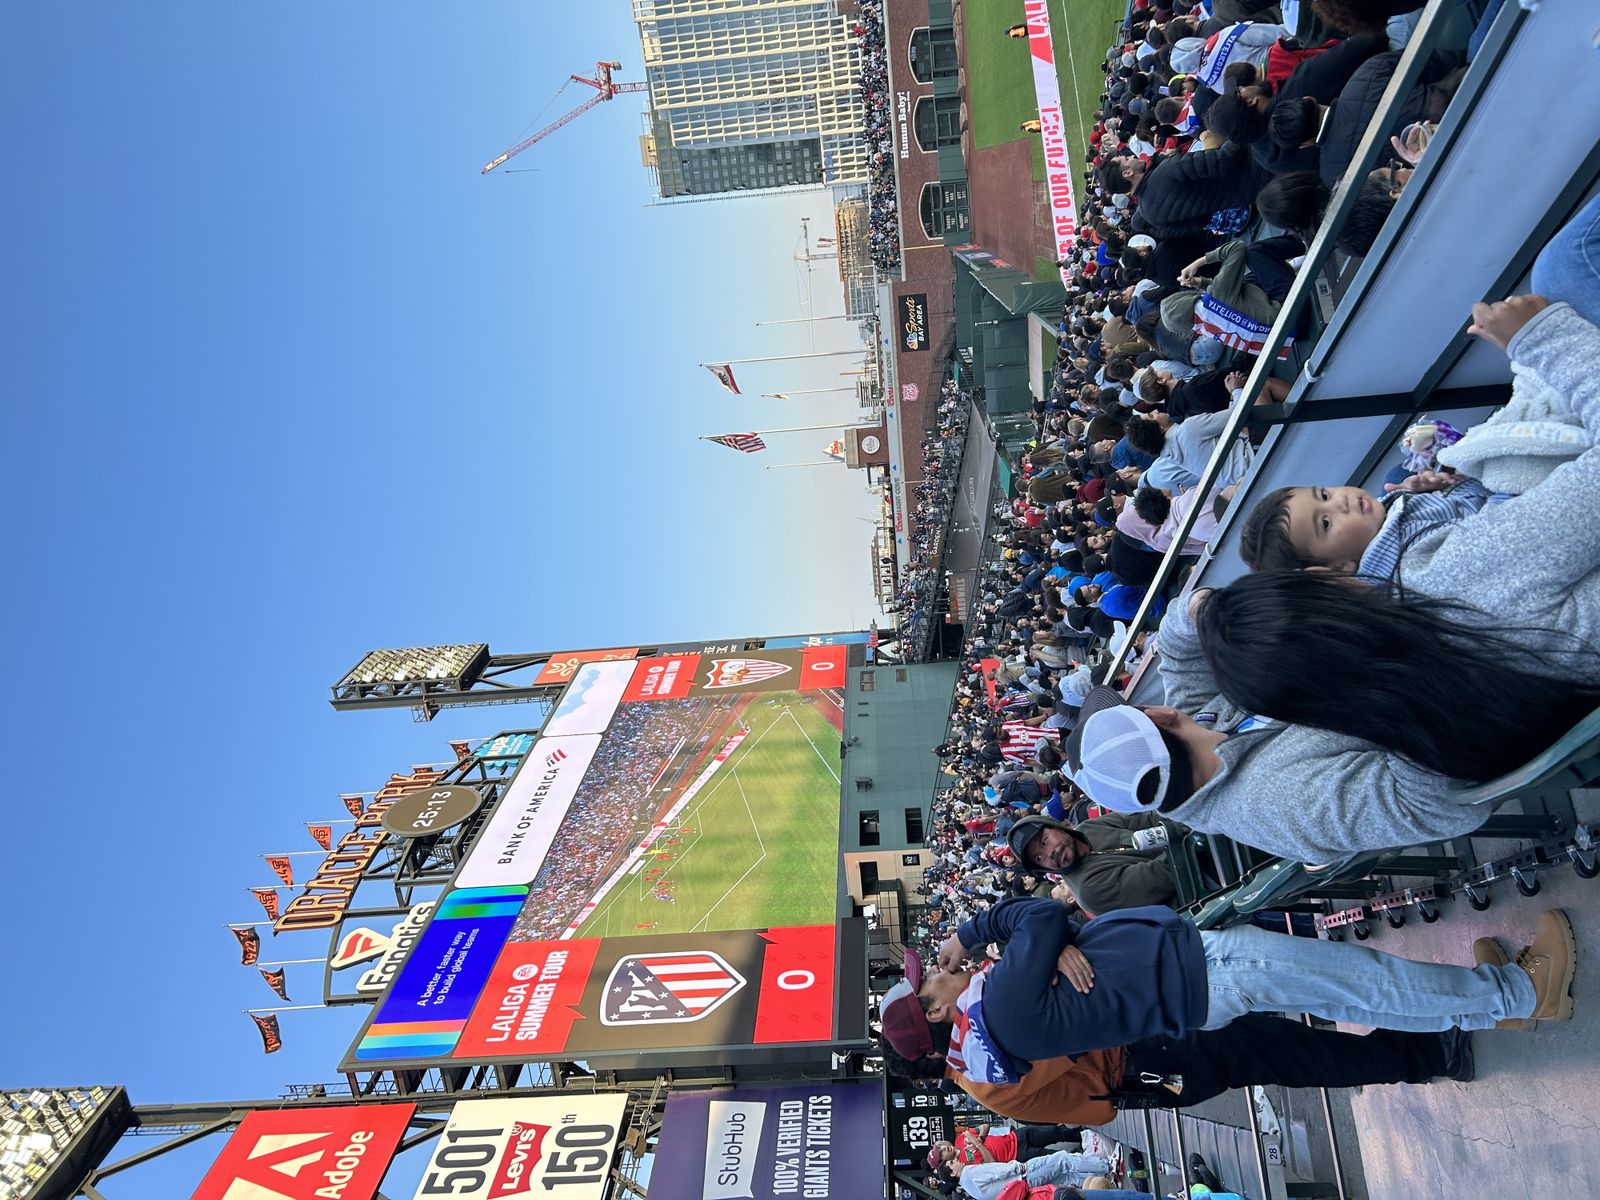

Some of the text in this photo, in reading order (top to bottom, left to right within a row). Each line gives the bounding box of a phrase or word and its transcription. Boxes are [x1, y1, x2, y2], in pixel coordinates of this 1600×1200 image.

[896, 91, 909, 159] Humm Baby!
[1050, 173, 1071, 209] OUR
[1055, 215, 1075, 236] OF
[1320, 284, 1328, 294] 22
[905, 296, 918, 334] Sports
[916, 304, 924, 325] AREA
[893, 477, 901, 495] COVE
[931, 529, 942, 555] GARDEN
[639, 673, 661, 696] LALIGA
[656, 672, 678, 695] SUMMER
[811, 661, 835, 671] 0
[412, 791, 452, 828] 25:13
[497, 768, 560, 864] BANK OF AMERICA
[273, 769, 448, 931] ORACLE PARK
[244, 940, 256, 964] 1922
[362, 905, 434, 986] Fanatics
[416, 931, 467, 1006] A better, faster way
[432, 928, 480, 1005] to build global teams
[777, 970, 815, 990] 0
[485, 983, 530, 1042] LALIGA
[514, 950, 569, 1040] SUMMER TOUR
[541, 1114, 615, 1190] 150 th
[717, 1112, 746, 1186] StubHub
[772, 1099, 804, 1195] 100% VERIFIED
[803, 1095, 832, 1198] GIANTS TICKETS
[908, 1116, 929, 1150] 139
[313, 1131, 374, 1199] Adobe
[421, 1128, 504, 1194] 501
[1269, 1147, 1278, 1160] 28
